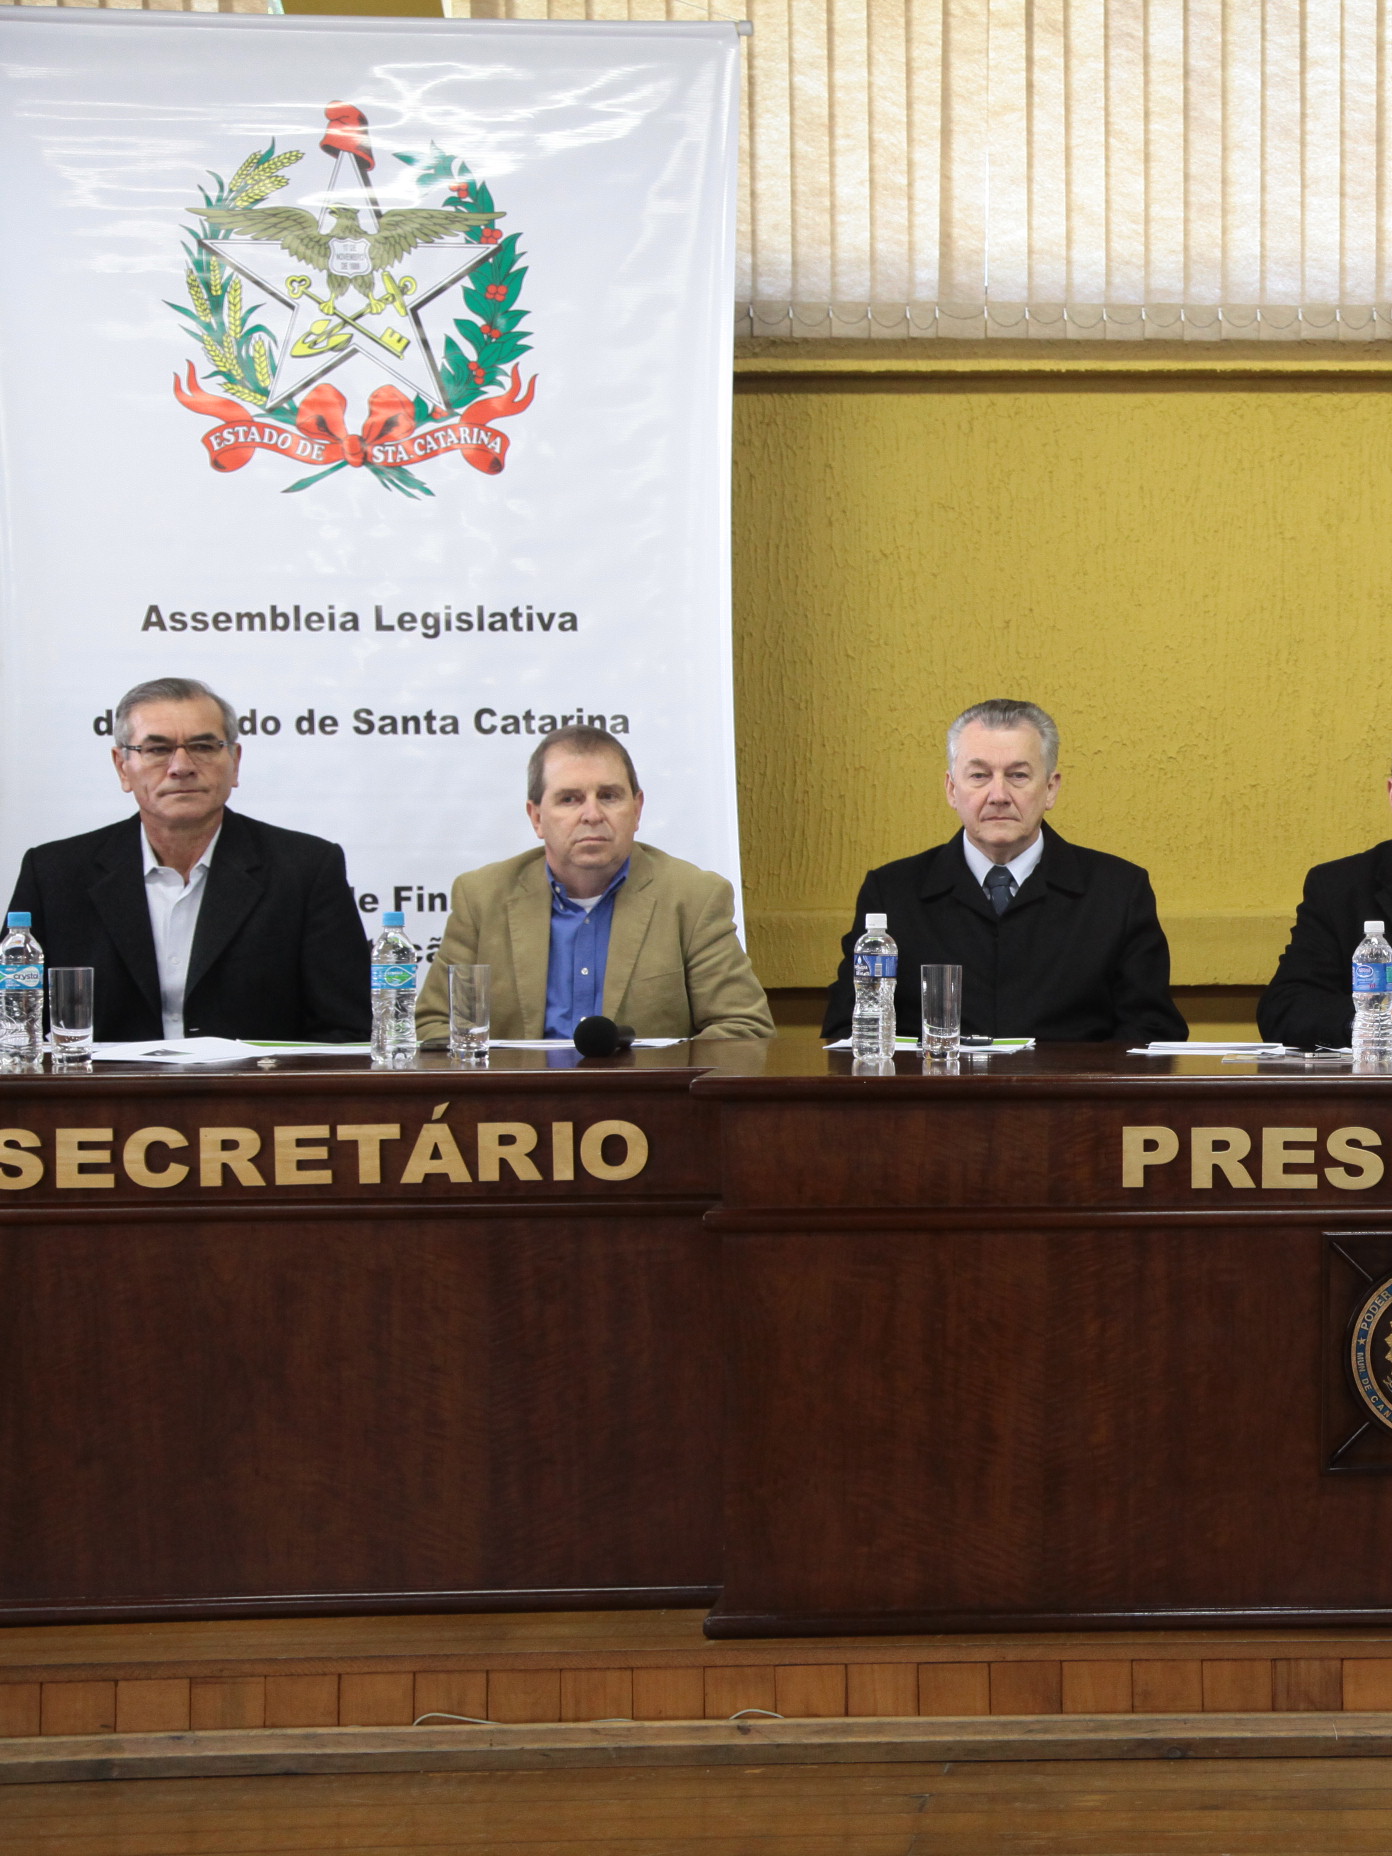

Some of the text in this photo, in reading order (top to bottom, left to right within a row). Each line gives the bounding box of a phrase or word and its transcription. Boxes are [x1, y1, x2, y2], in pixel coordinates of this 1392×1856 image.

[210, 426, 293, 451] ESTADO
[296, 438, 325, 460] DE
[414, 422, 502, 454] CATARINA
[140, 604, 579, 639] Assembleia Legislativa
[295, 708, 339, 736] de
[352, 708, 460, 737] Santa
[474, 707, 630, 735] Catarina
[393, 886, 448, 912] Fin
[0, 1101, 649, 1191] SECRETÁRIO
[1361, 1290, 1391, 1331] PODER
[1361, 1378, 1371, 1391] DE
